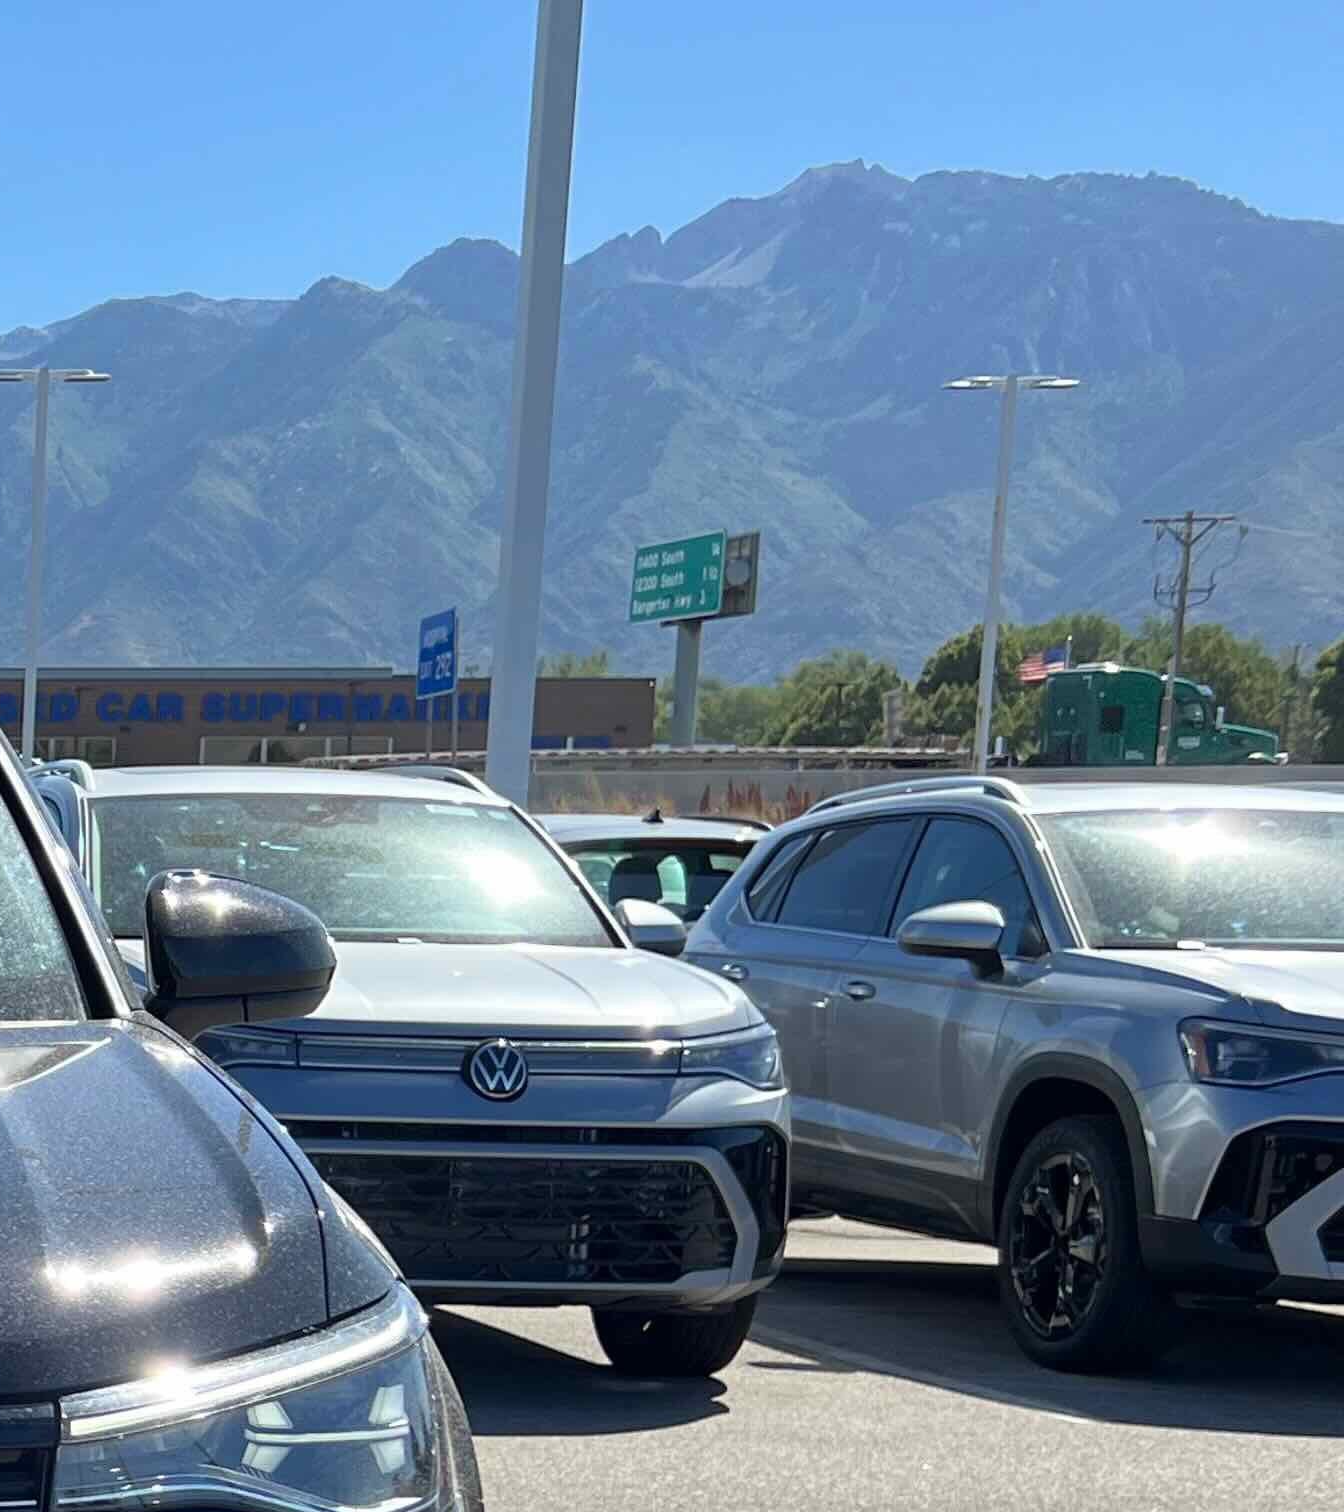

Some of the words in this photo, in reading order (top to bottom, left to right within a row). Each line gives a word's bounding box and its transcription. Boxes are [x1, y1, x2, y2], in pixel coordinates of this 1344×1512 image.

[661, 550, 685, 567] South
[660, 571, 684, 589] South
[96, 692, 185, 722] CAR
[470, 1038, 526, 1098] VW
